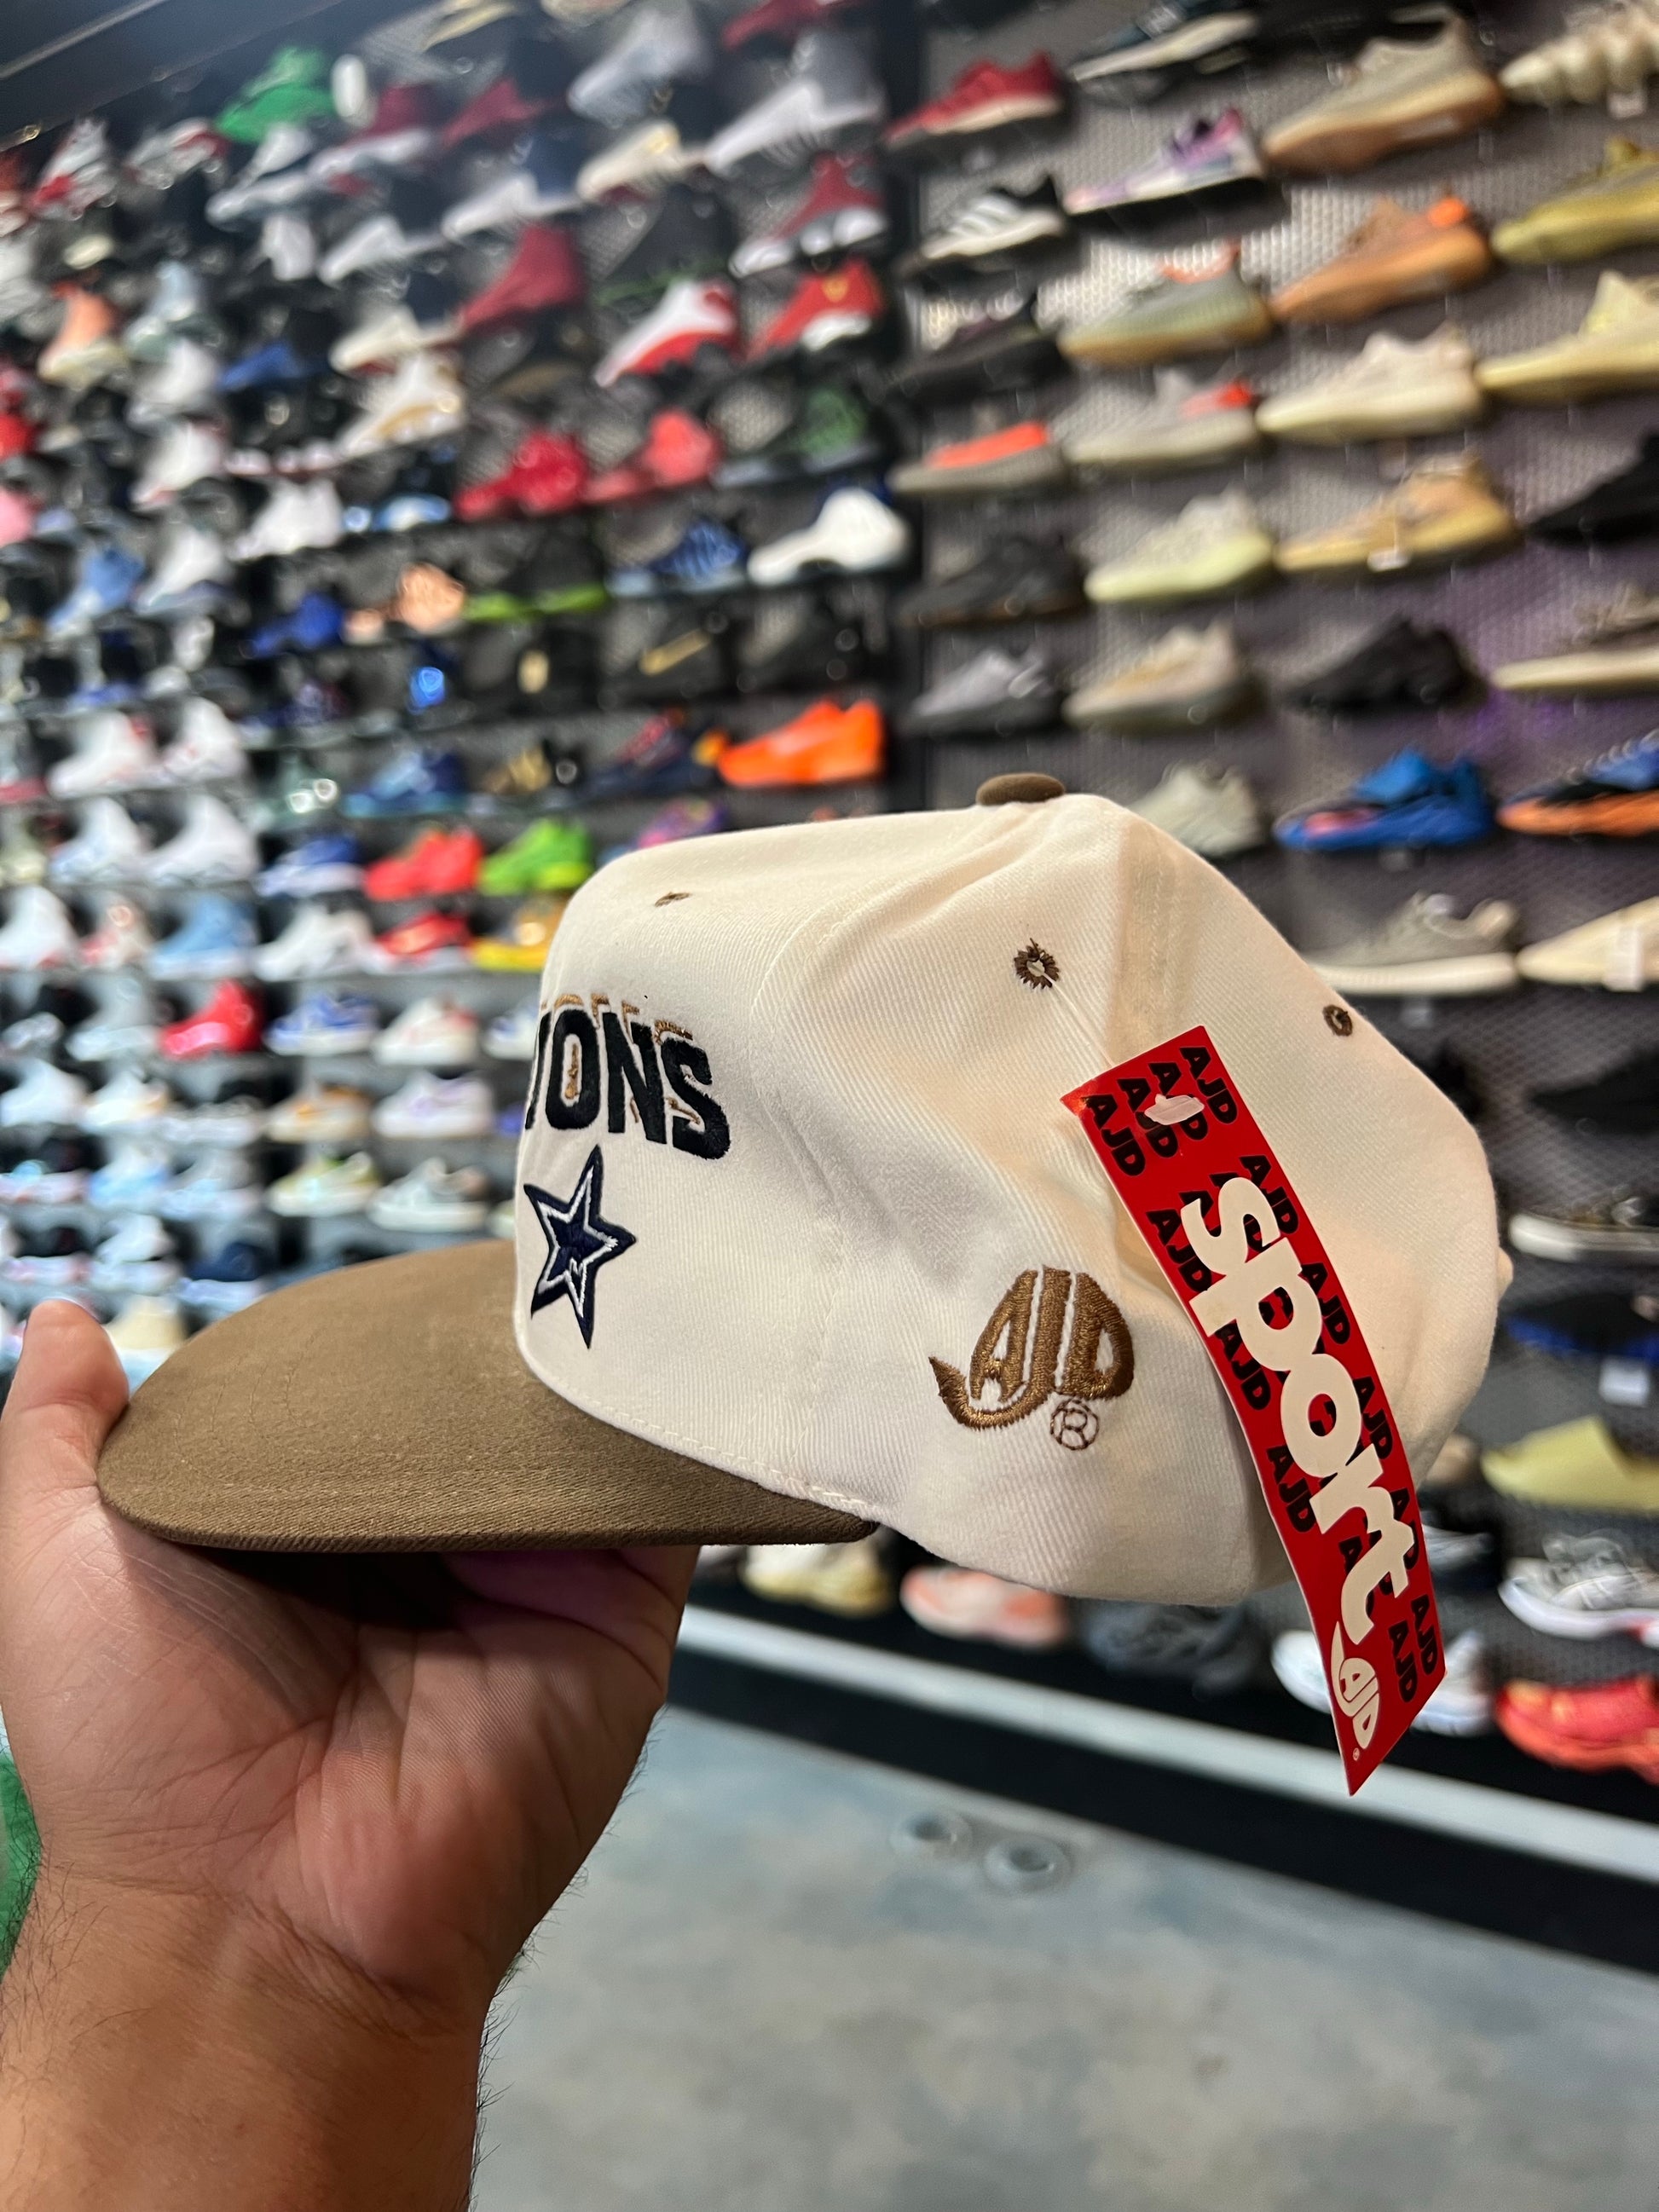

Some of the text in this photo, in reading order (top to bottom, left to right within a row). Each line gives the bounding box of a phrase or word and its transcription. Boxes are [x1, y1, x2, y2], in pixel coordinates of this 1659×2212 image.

[1147, 1061, 1209, 1141] AD
[1180, 1046, 1238, 1124] AJD
[1080, 1094, 1147, 1176] AJD
[1145, 1209, 1213, 1294] AJD
[928, 1264, 1135, 1431] AJD
[1214, 1320, 1272, 1411] AJD
[1180, 1176, 1415, 1645] sport
[1352, 1376, 1394, 1460] AJD
[1266, 1446, 1316, 1533] AJD
[1388, 1620, 1419, 1703] AJD
[1411, 1593, 1438, 1677] AJD
